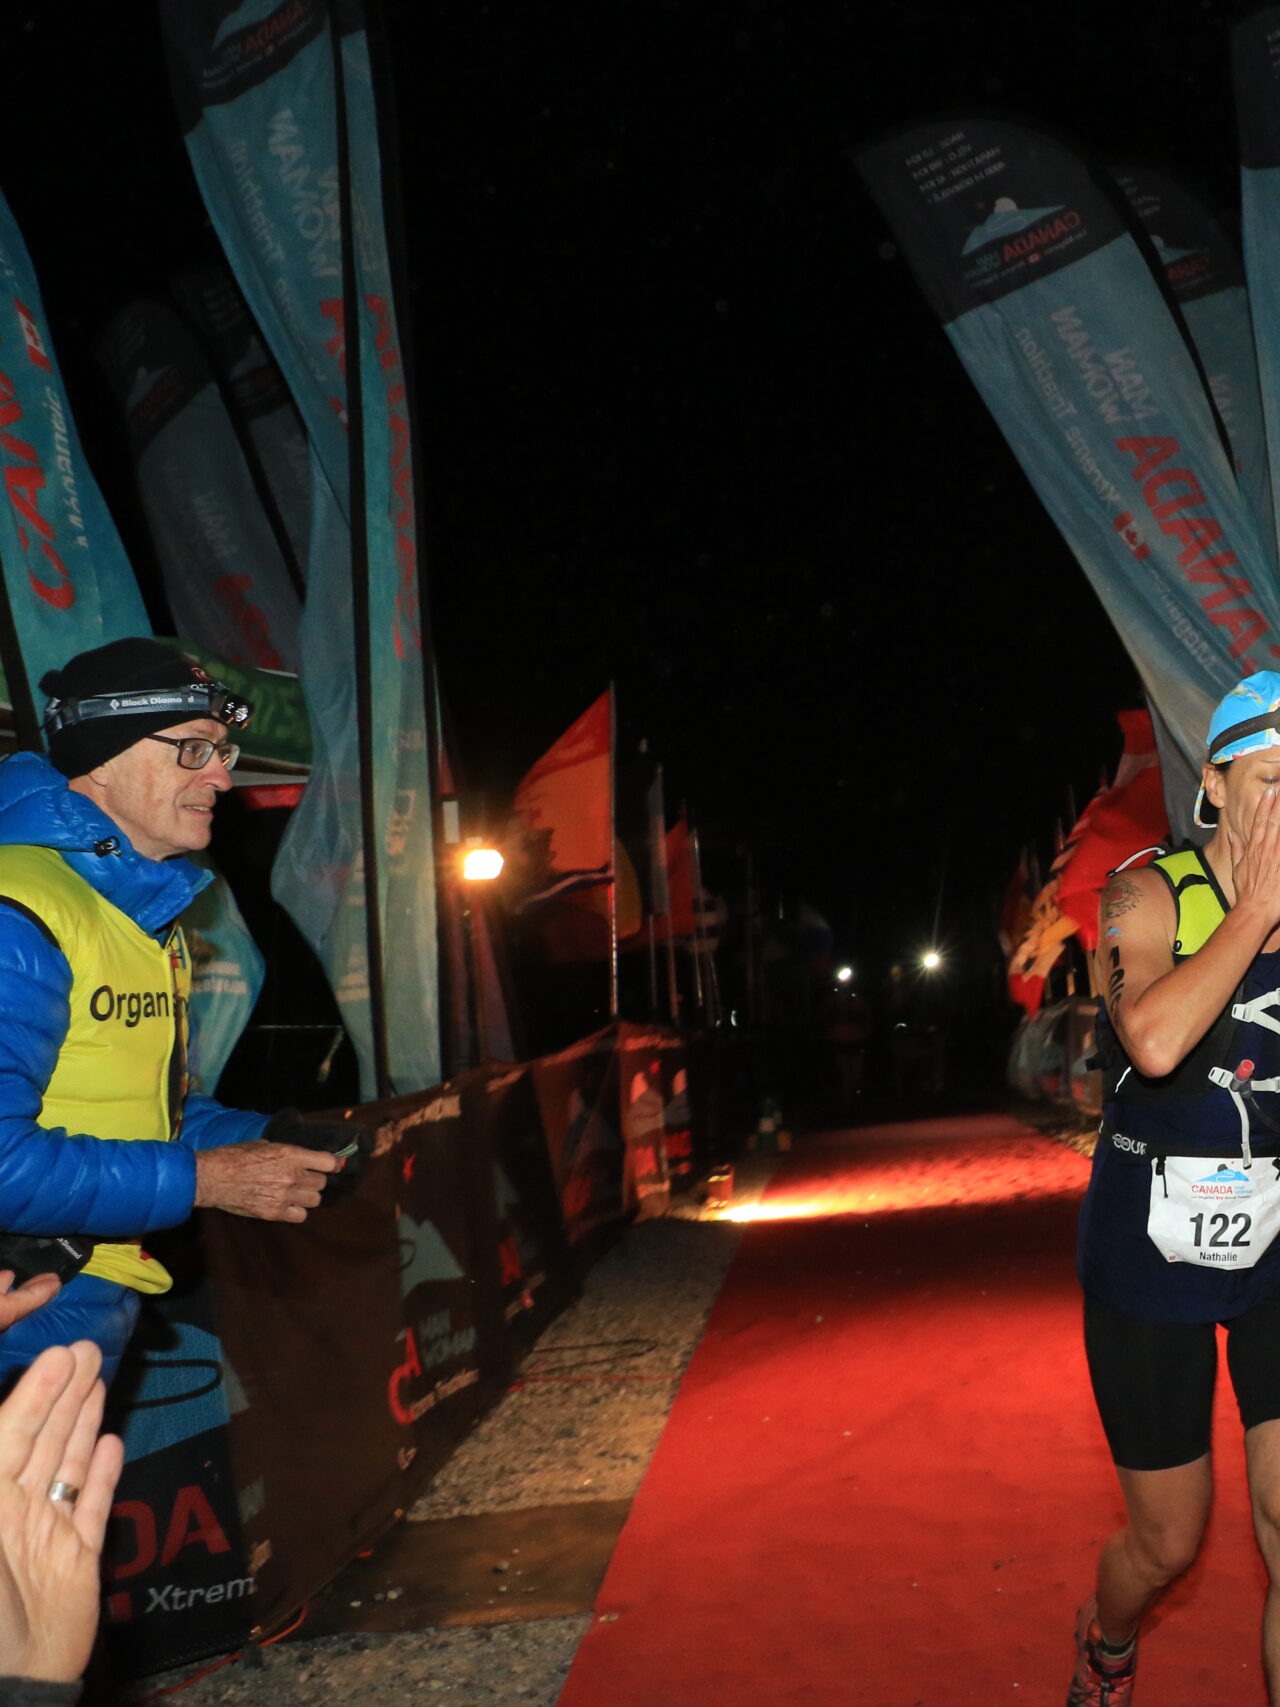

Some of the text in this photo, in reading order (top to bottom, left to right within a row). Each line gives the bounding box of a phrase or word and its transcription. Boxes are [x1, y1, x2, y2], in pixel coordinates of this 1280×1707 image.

[121, 696, 194, 707] Black Diamod
[1191, 1184, 1233, 1195] CANADA
[1189, 1212, 1252, 1248] 122
[1199, 1251, 1238, 1263] Nathalie
[144, 1575, 258, 1614] Xtrem
